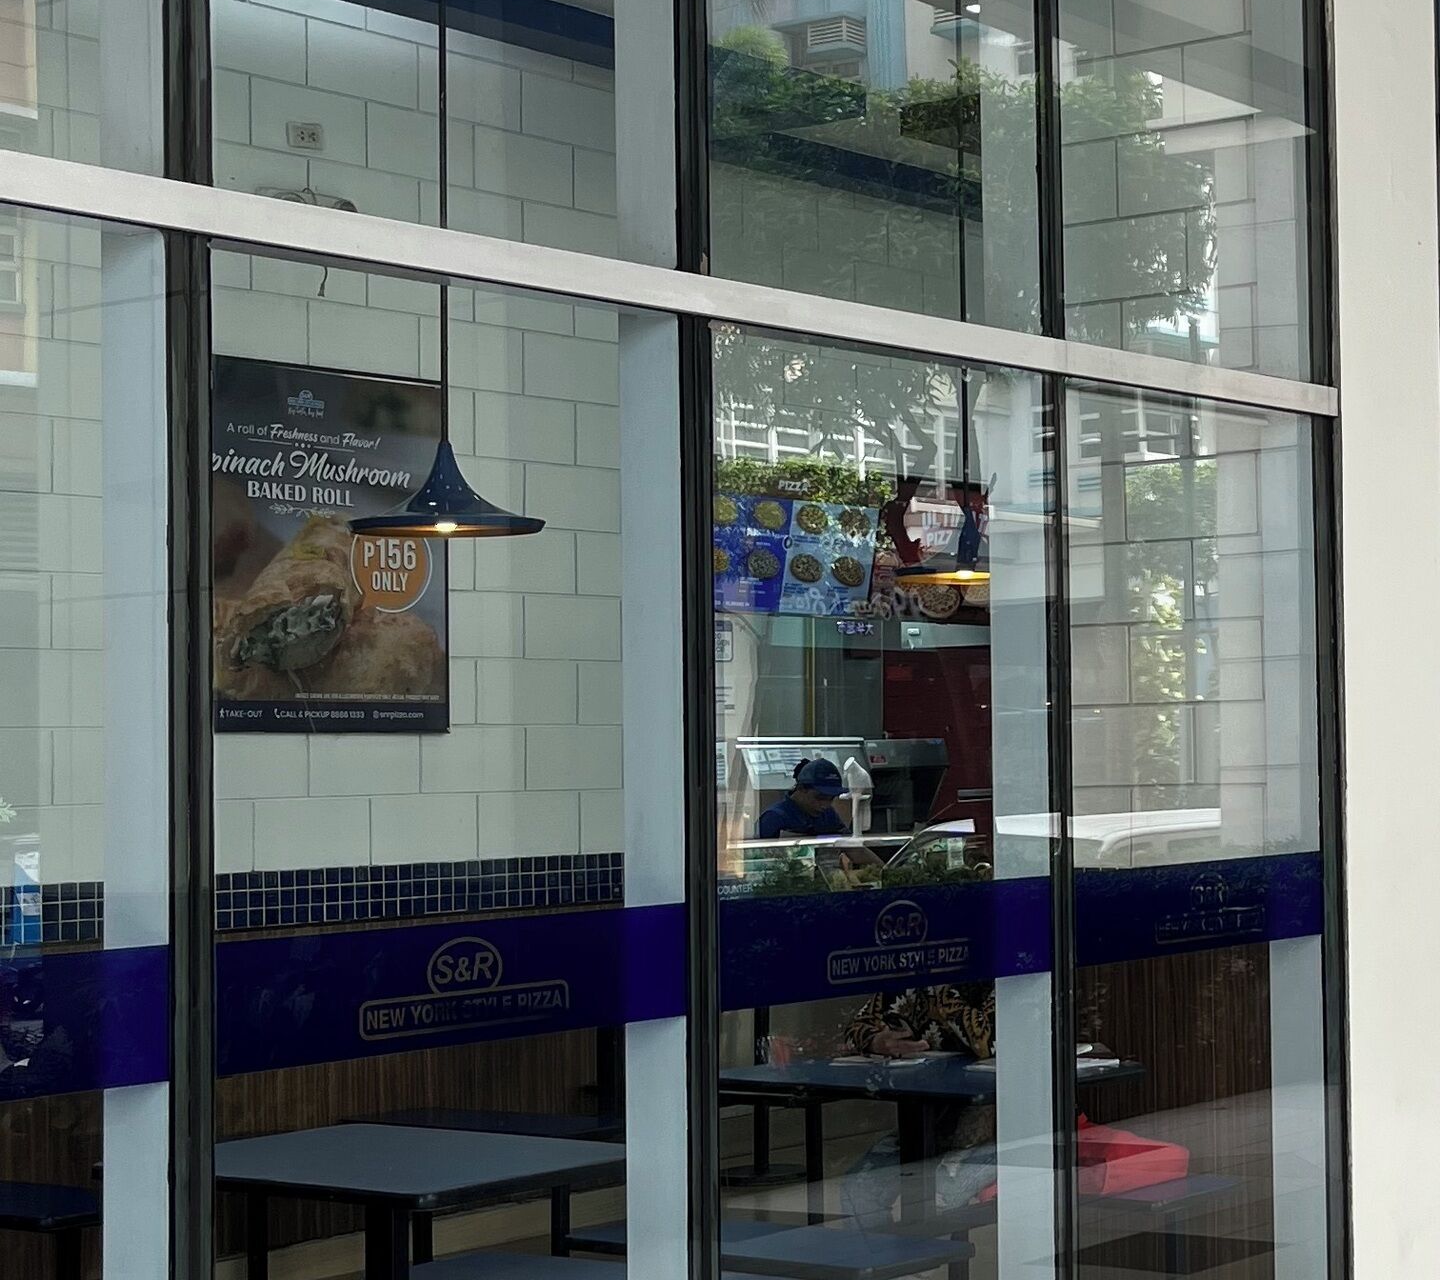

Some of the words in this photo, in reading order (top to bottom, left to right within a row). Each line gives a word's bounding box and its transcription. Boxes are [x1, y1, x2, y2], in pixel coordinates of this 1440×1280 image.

[226, 422, 235, 433] A
[237, 425, 255, 435] roll
[256, 425, 269, 436] of
[269, 423, 318, 443] Freshness
[319, 434, 340, 445] and
[341, 432, 382, 450] Flavor!
[289, 450, 412, 489] Mushroom
[247, 480, 306, 502] BAKED
[312, 486, 355, 507] ROLL
[372, 571, 408, 592] ONLY
[717, 883, 754, 895] COUNTER
[879, 912, 922, 939] S&R
[434, 950, 495, 985] S&R
[832, 958, 860, 976] NEW
[862, 953, 896, 971] YORK
[937, 945, 969, 963] PIZZA
[366, 1006, 406, 1031] NEW
